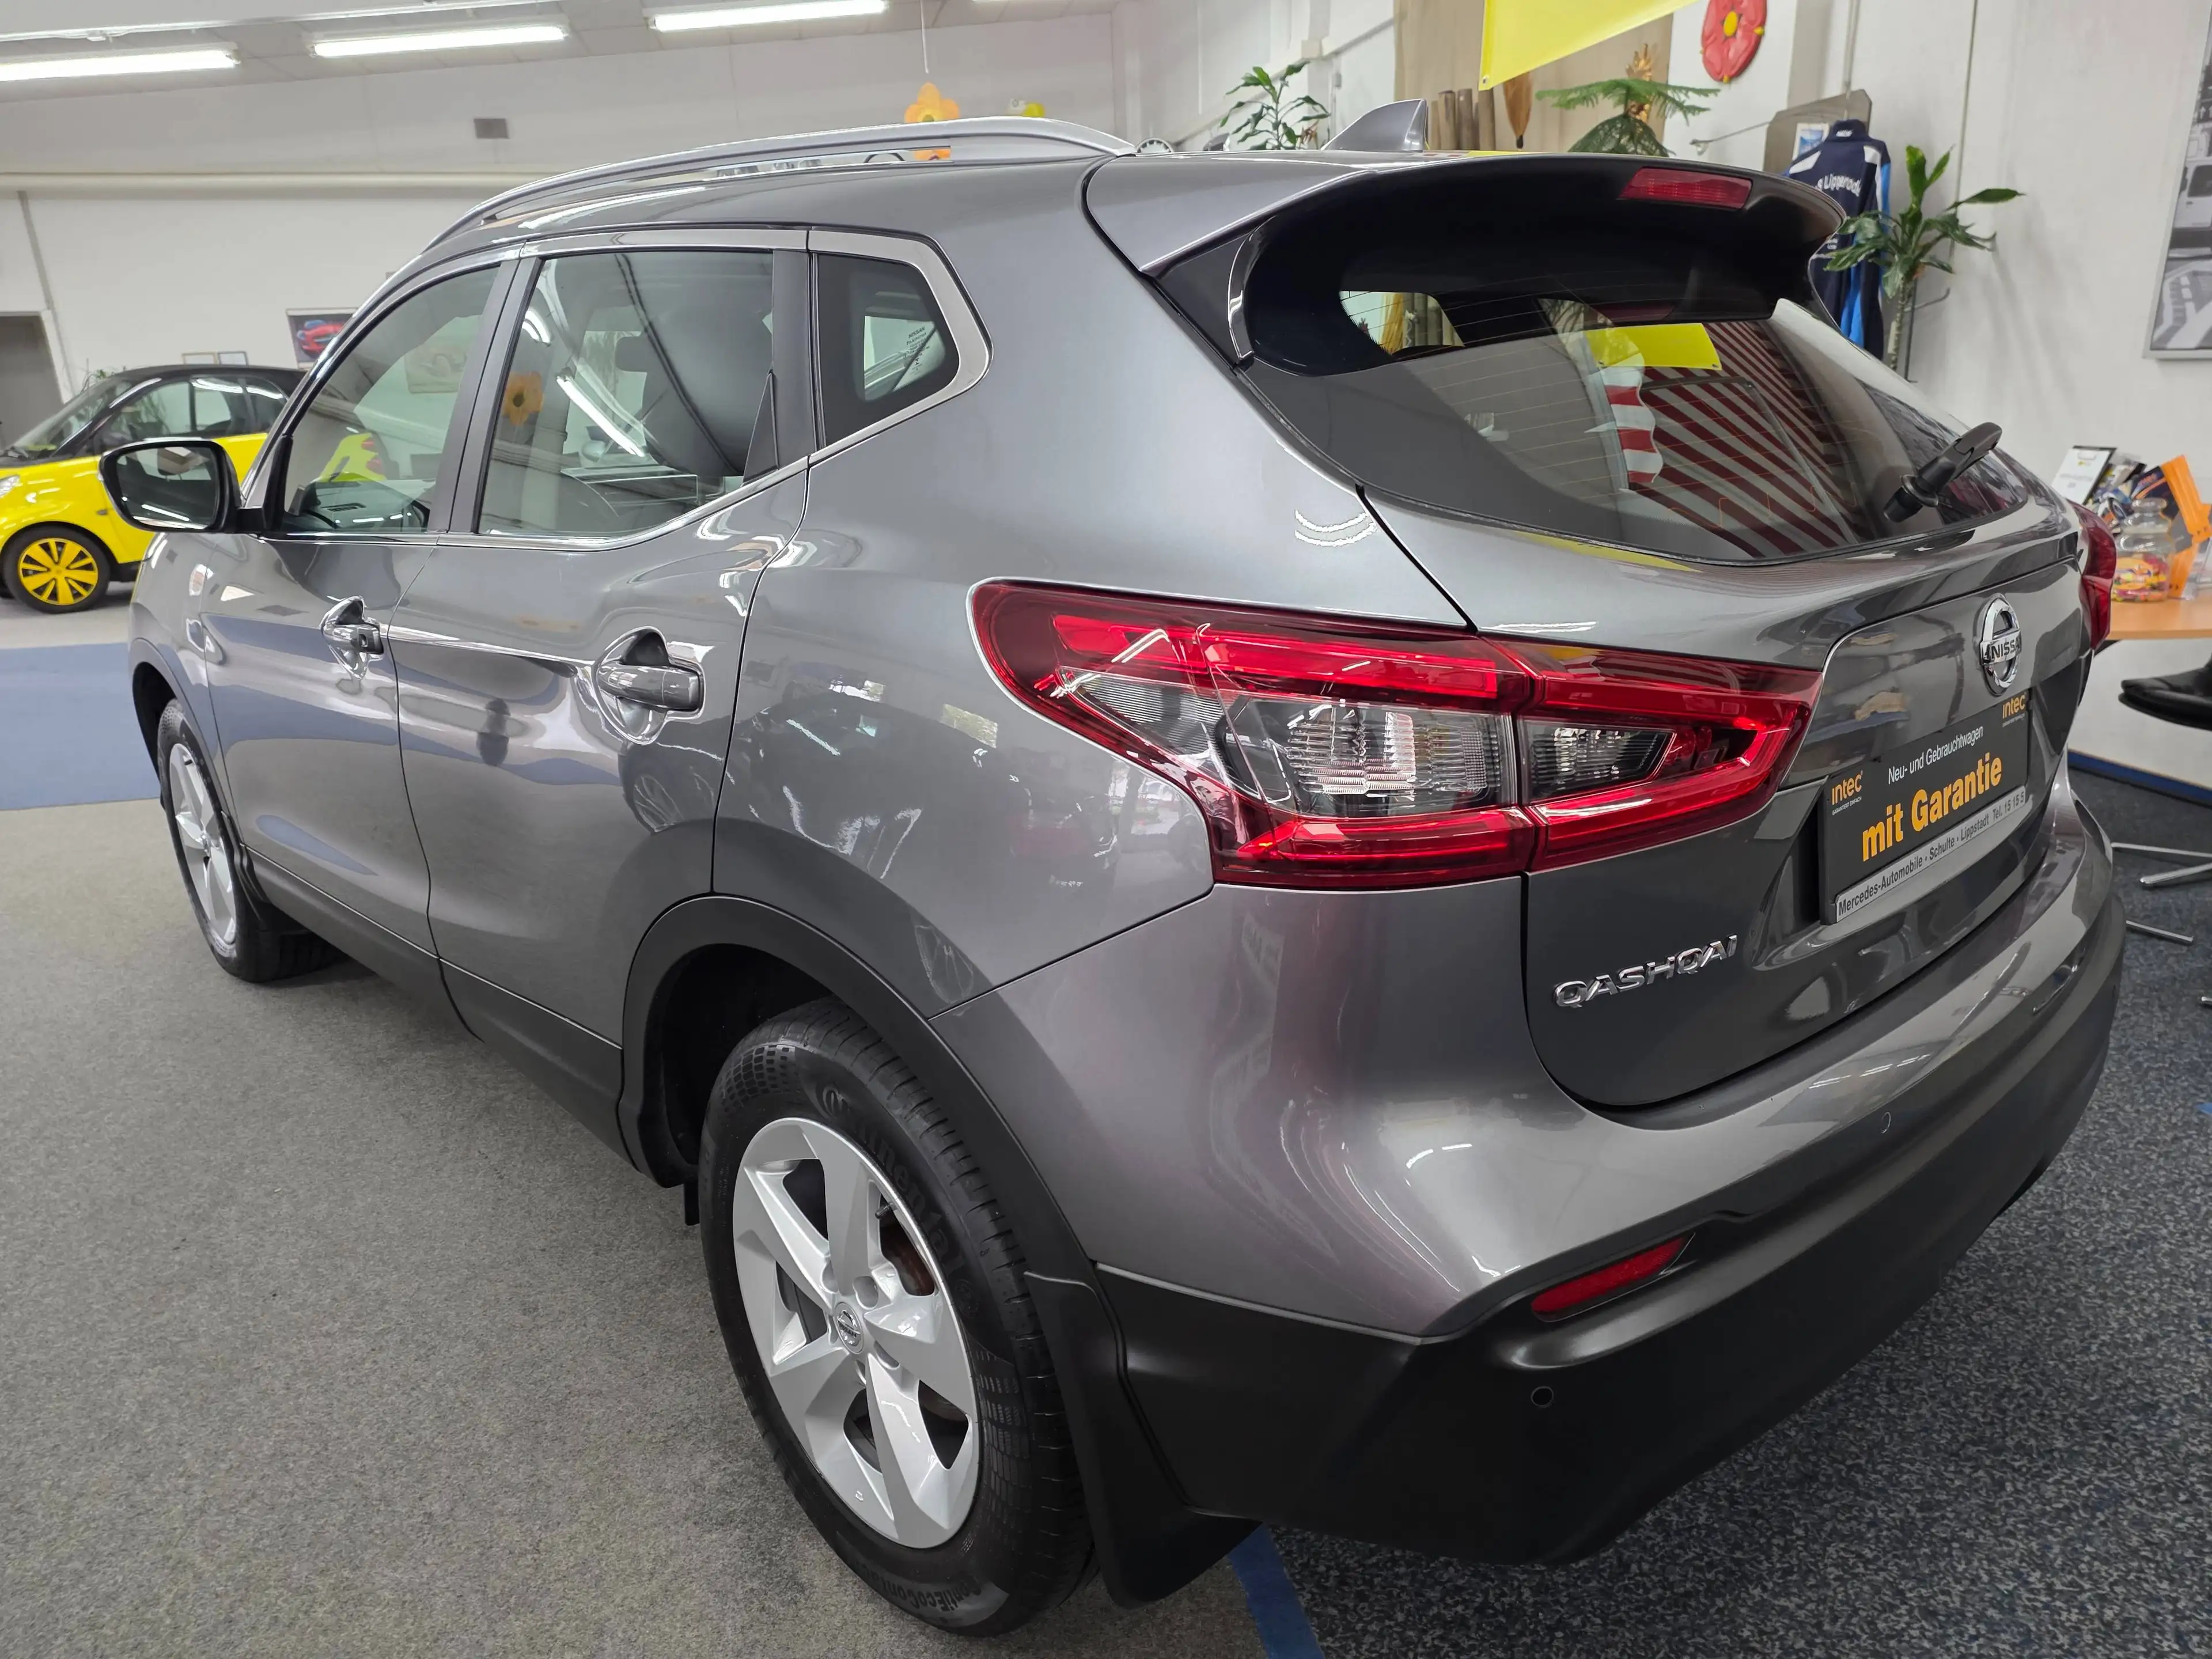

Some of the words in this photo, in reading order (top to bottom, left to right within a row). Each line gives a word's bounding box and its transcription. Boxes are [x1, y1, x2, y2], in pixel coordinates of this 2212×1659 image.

[2002, 695, 2025, 718] intec
[1888, 766, 1908, 785] Neu-
[1910, 752, 1925, 774] und
[1926, 726, 1983, 766] Gebrauchtwagen
[1832, 774, 1862, 805] intec
[1862, 802, 1903, 862] mit
[1911, 752, 2002, 832] Garantie
[1839, 855, 1923, 916] Mercedes-Automobile
[1930, 837, 1955, 860] Schulte
[1961, 814, 1990, 842] Lippstadt
[1993, 808, 2002, 822] Tel.
[1554, 934, 1737, 1008] QASHQAI
